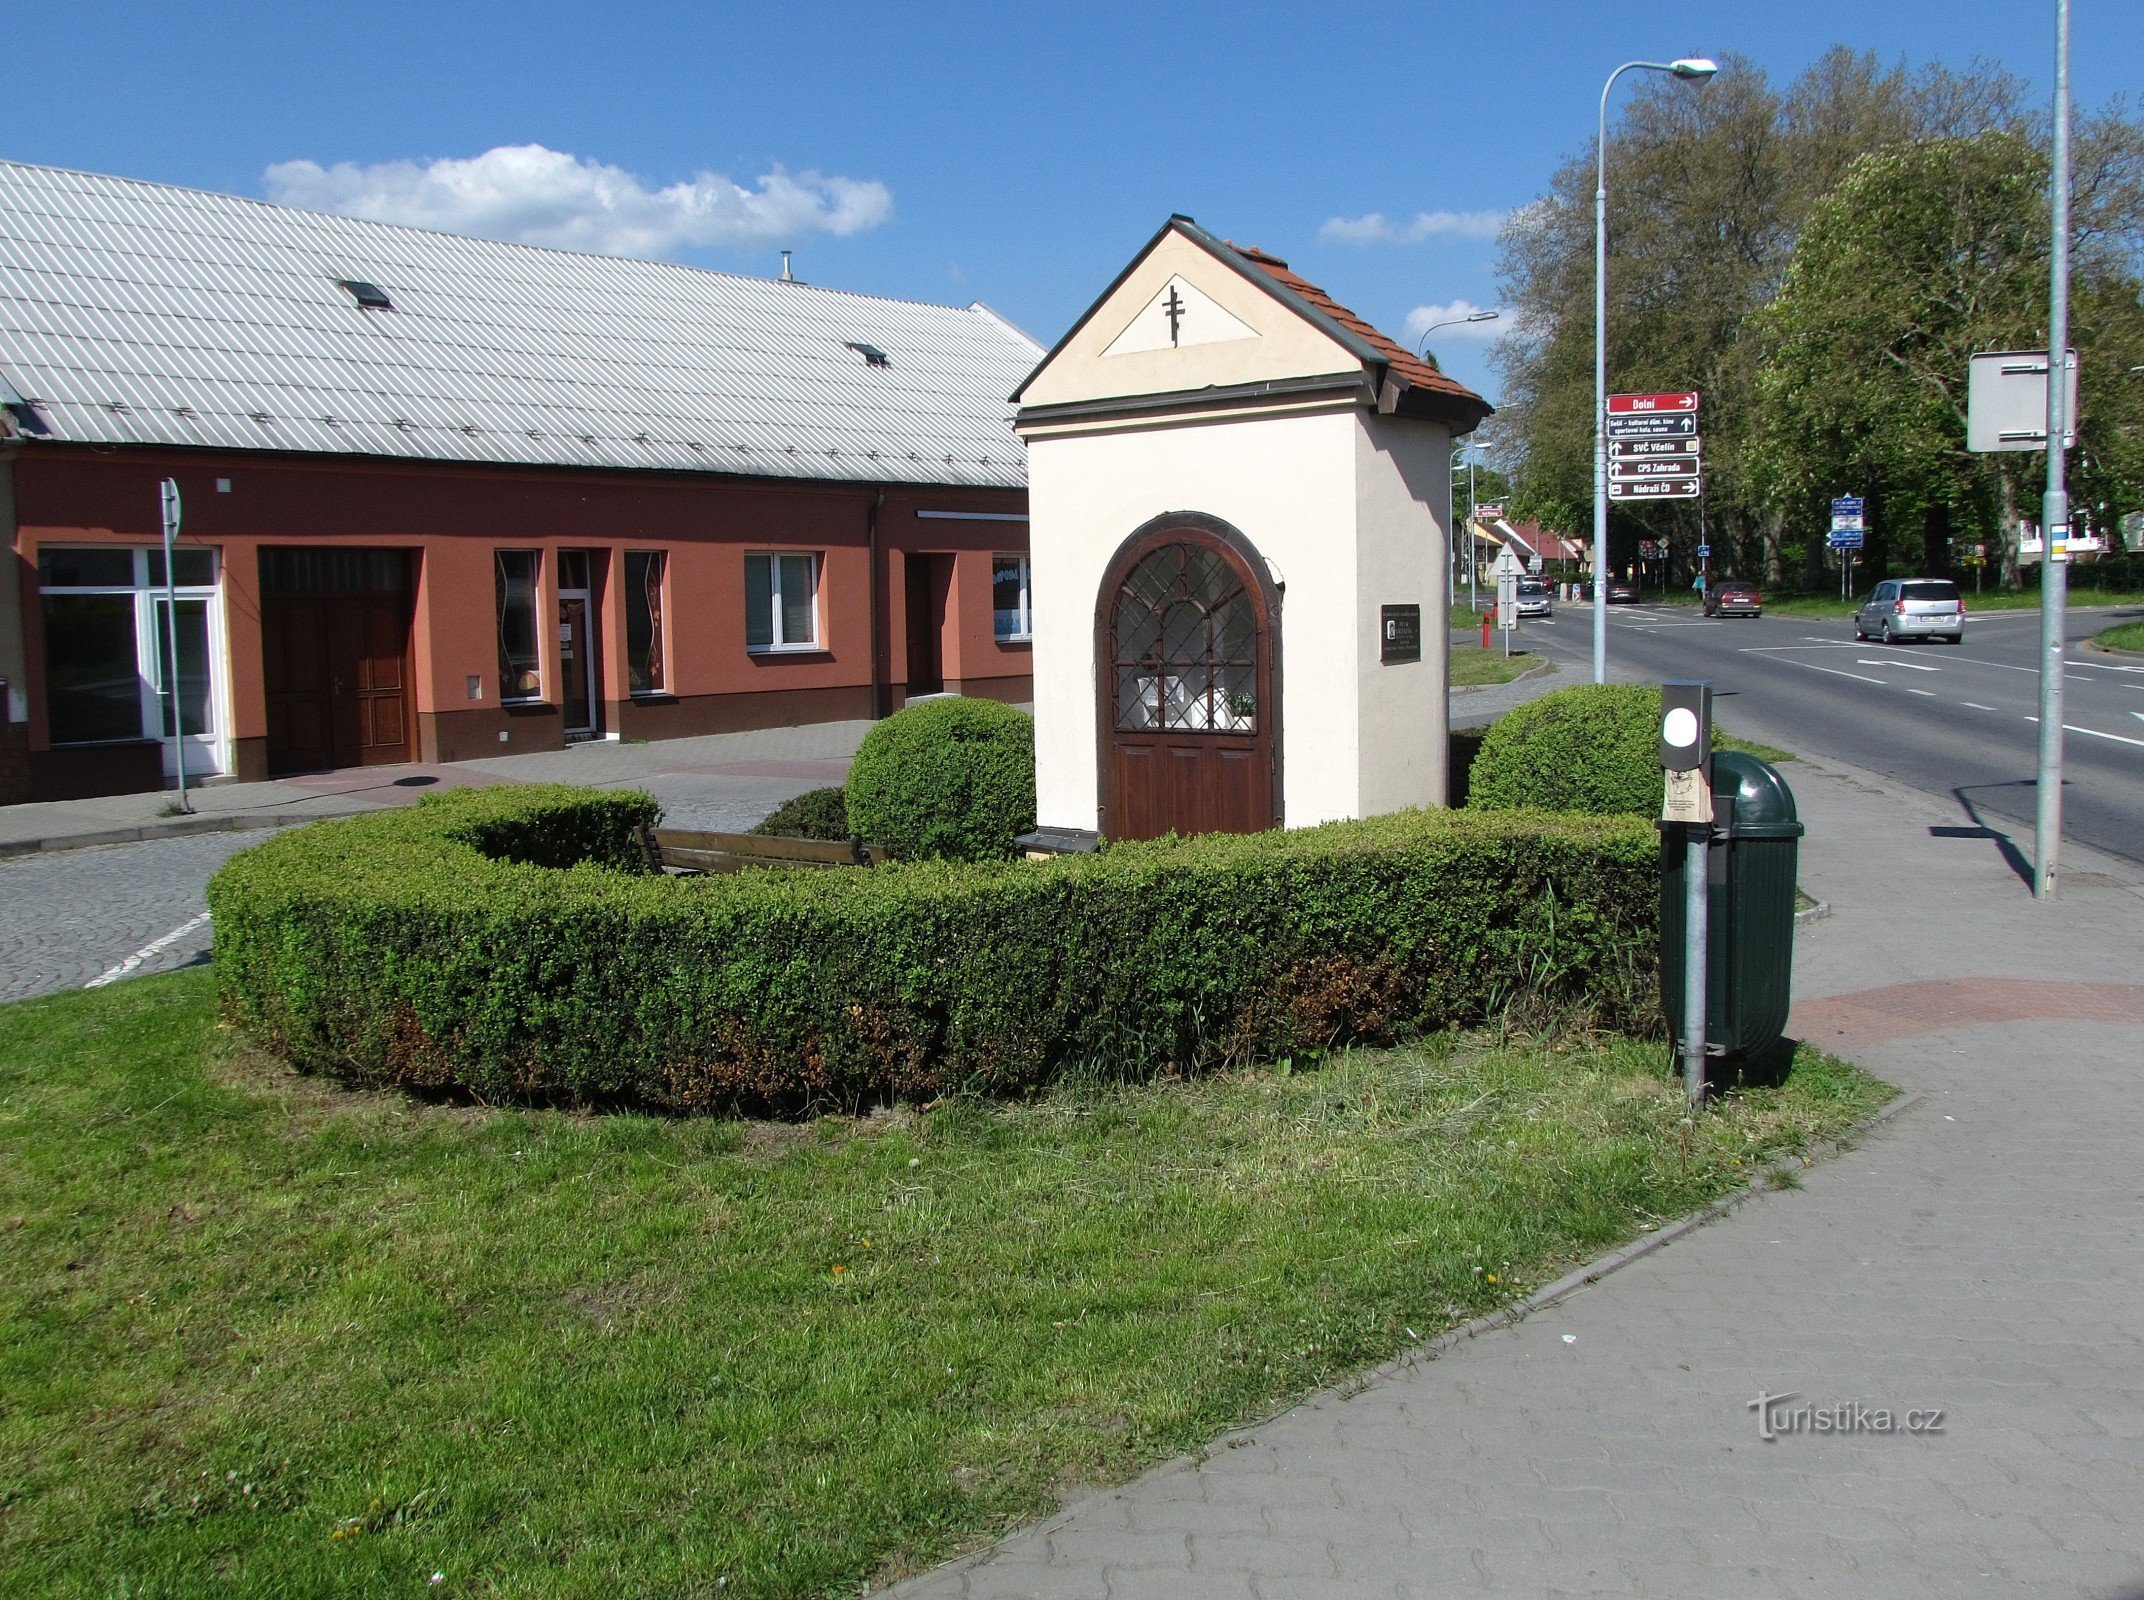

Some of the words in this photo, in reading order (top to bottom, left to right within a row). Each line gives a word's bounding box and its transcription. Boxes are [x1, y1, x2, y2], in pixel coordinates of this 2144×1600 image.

[1633, 399, 1655, 409] Dolní
[1615, 427, 1639, 435] sportovní
[1633, 442, 1650, 453] SVČ
[1651, 442, 1675, 452] Včelín
[1637, 463, 1651, 473] CPS
[1652, 462, 1681, 472] Zahrada
[1633, 483, 1660, 494] Nádraží
[1660, 482, 1670, 493] ČD
